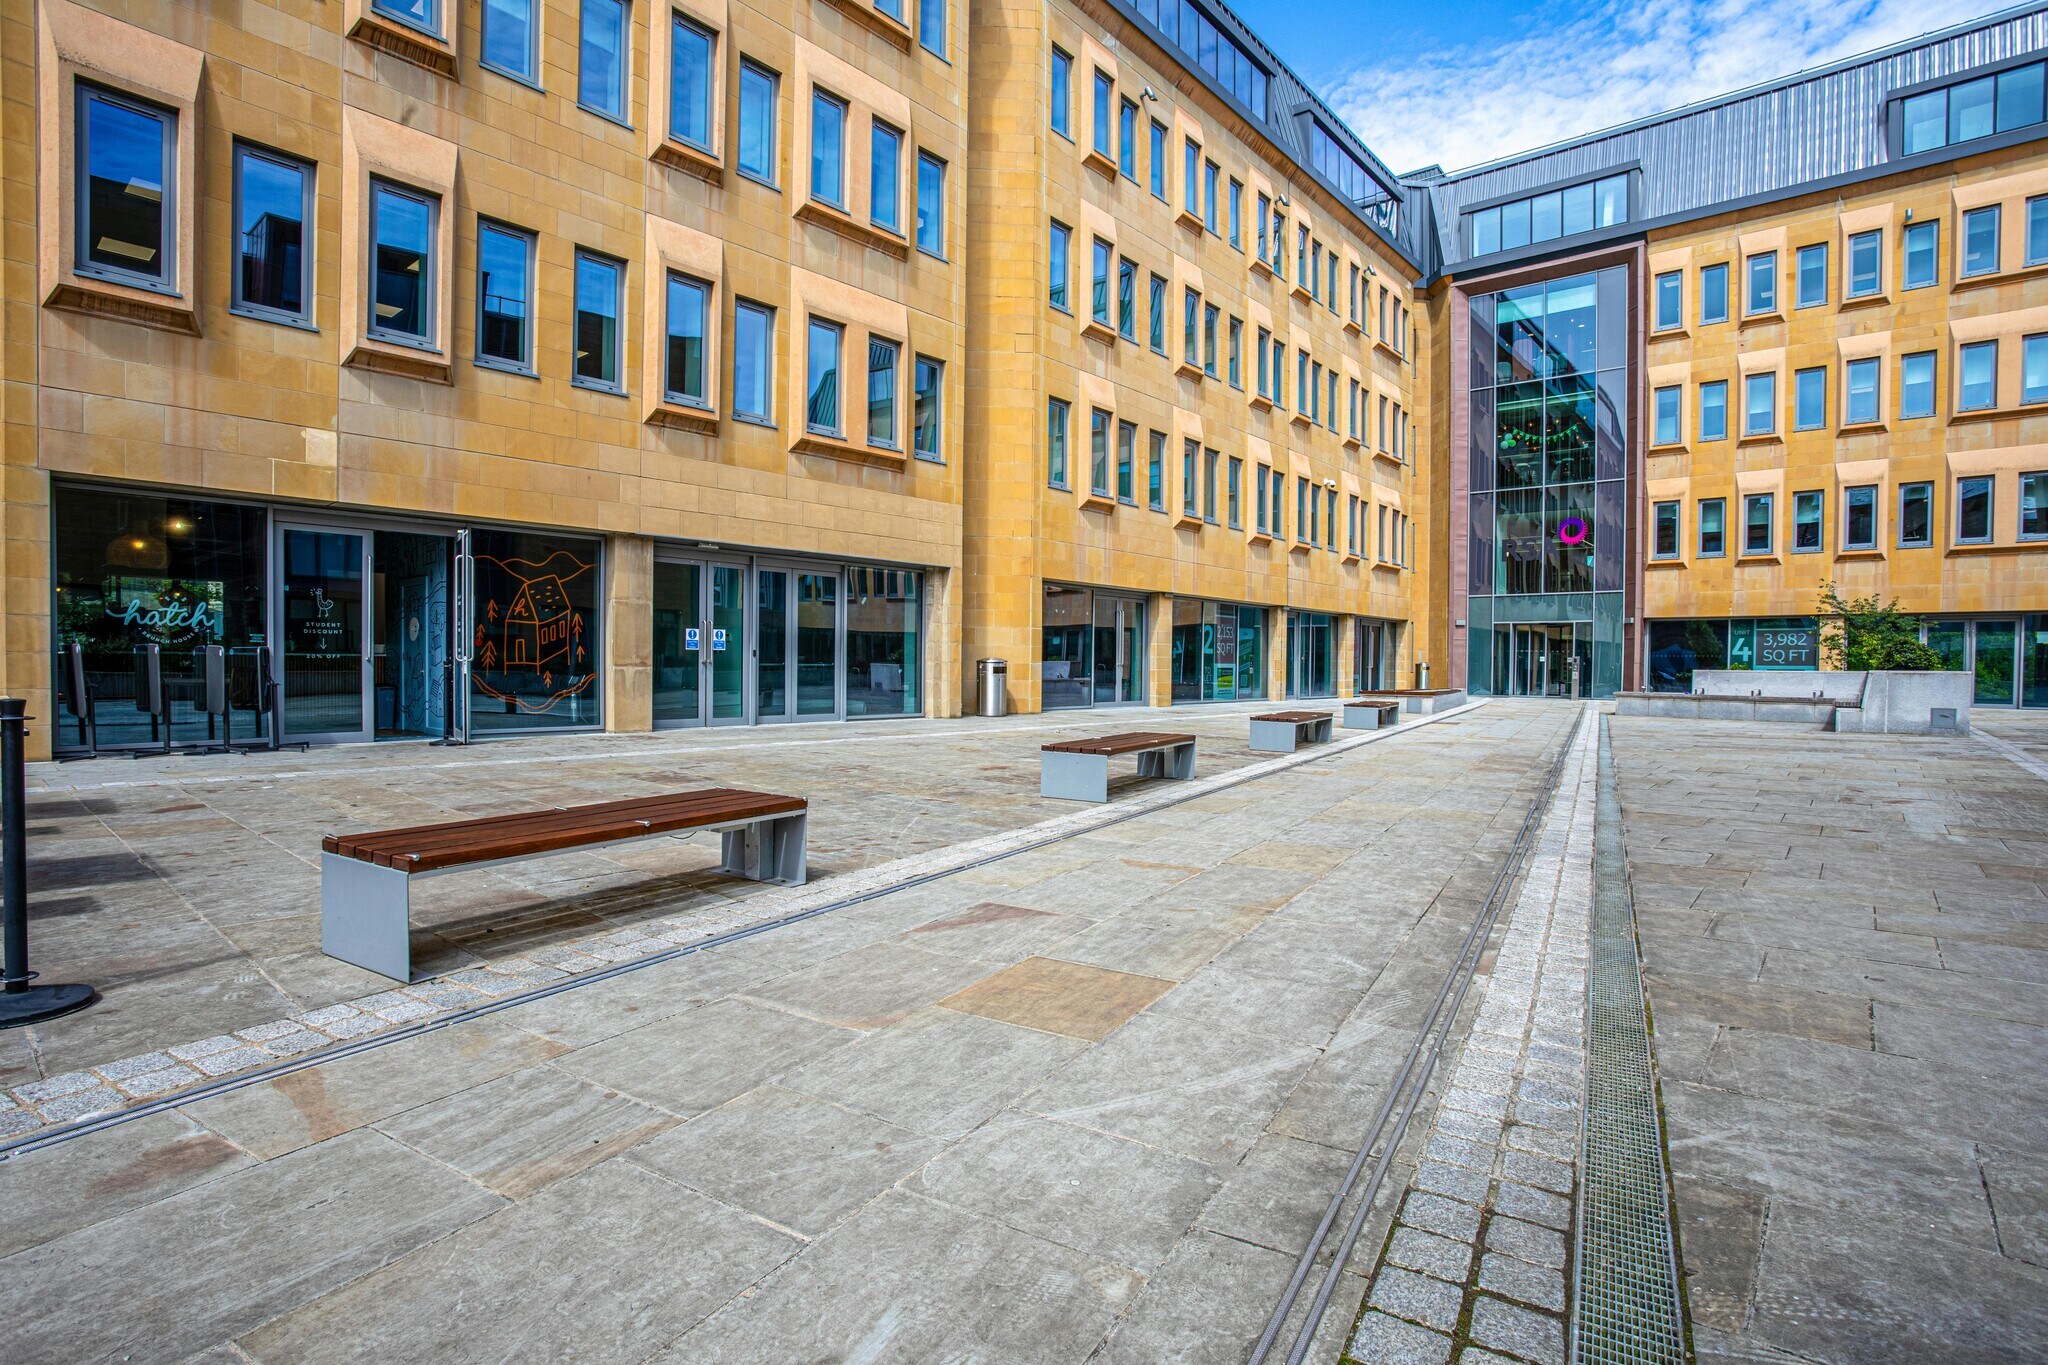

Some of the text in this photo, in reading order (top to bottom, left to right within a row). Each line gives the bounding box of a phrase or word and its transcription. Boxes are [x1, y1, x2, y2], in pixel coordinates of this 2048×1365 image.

[1502, 536, 1560, 562] RSA
[106, 599, 215, 627] hatch
[514, 598, 529, 616] h
[142, 631, 170, 644] BRUNCH
[1204, 625, 1213, 654] 2
[1217, 626, 1234, 639] 2,153
[1763, 633, 1807, 648] 3,982
[1217, 643, 1226, 655] SQ
[1226, 643, 1235, 654] FT
[1732, 638, 1752, 662] 4
[1762, 650, 1810, 664] SQ FT
